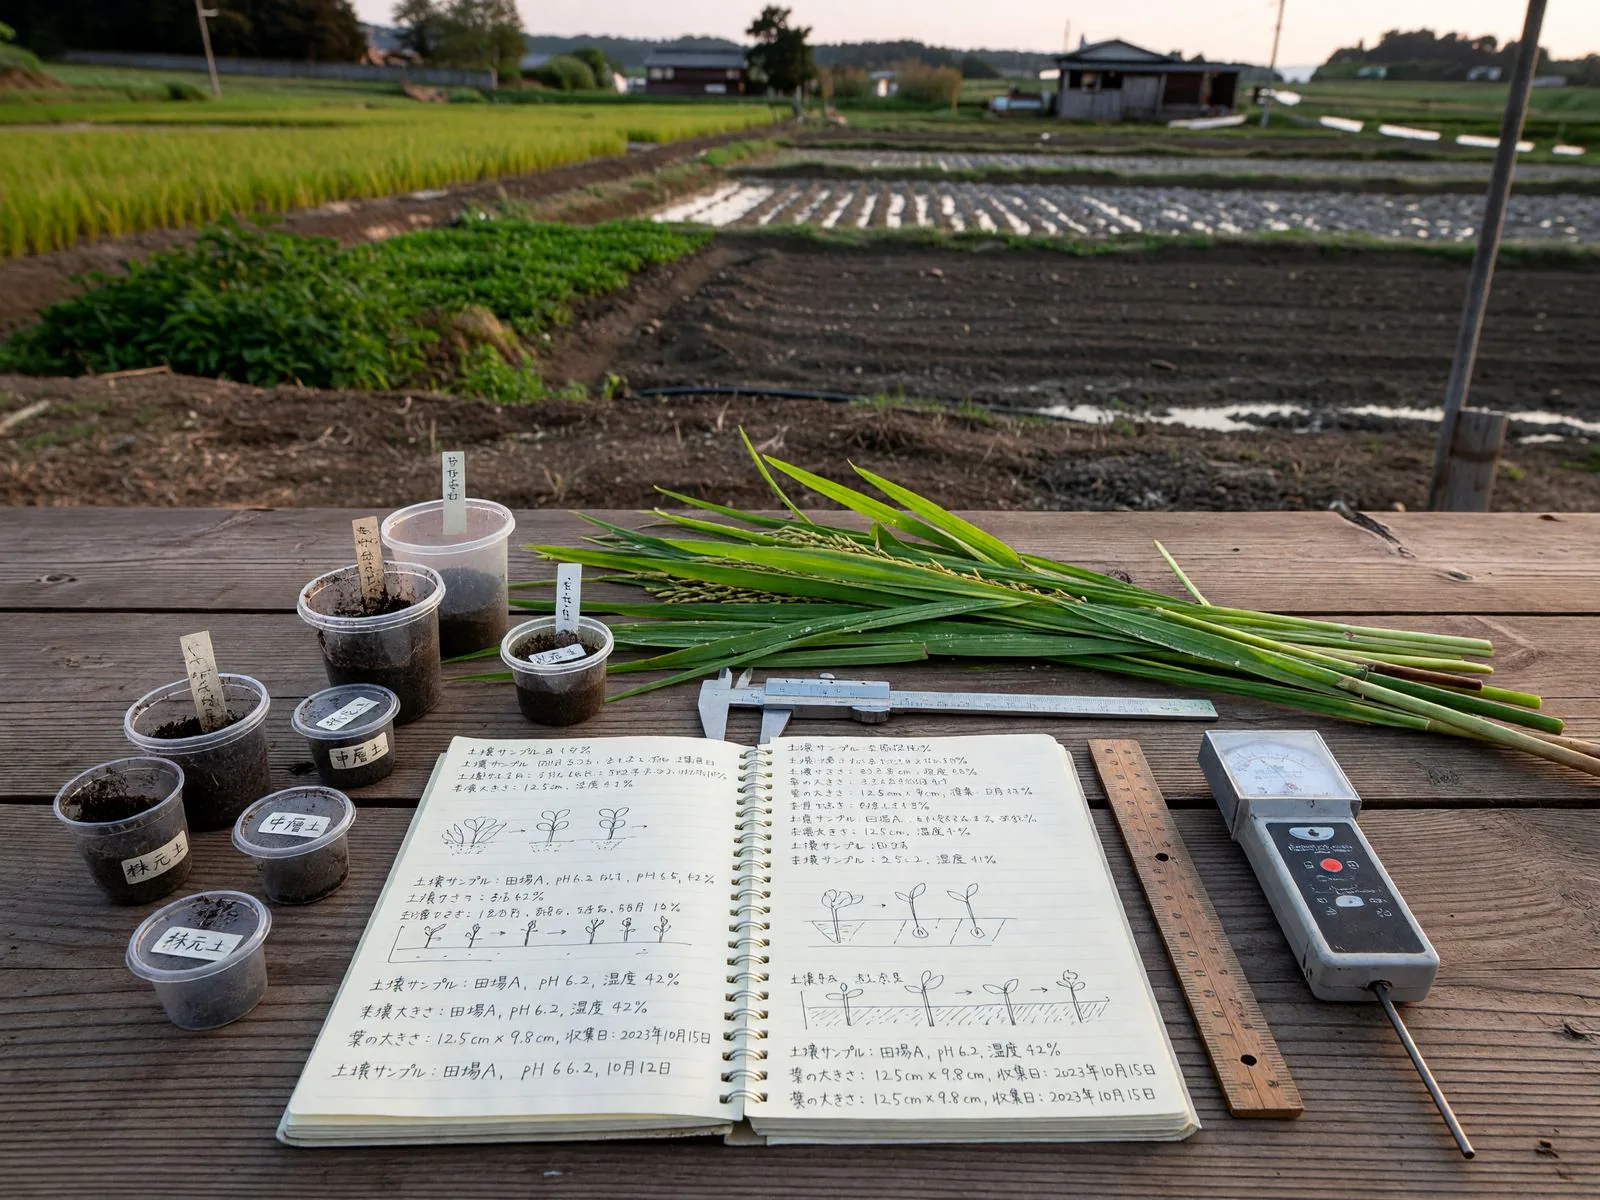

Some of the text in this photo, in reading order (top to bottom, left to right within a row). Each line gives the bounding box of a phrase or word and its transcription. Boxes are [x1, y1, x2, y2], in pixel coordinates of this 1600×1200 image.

[539, 976, 559, 990] pH
[645, 972, 679, 986] 42%
[509, 1004, 530, 1021] pH
[612, 1001, 647, 1014] 42%
[938, 1045, 954, 1062] pH
[1026, 1042, 1060, 1056] 42%
[521, 1062, 544, 1080] pH
